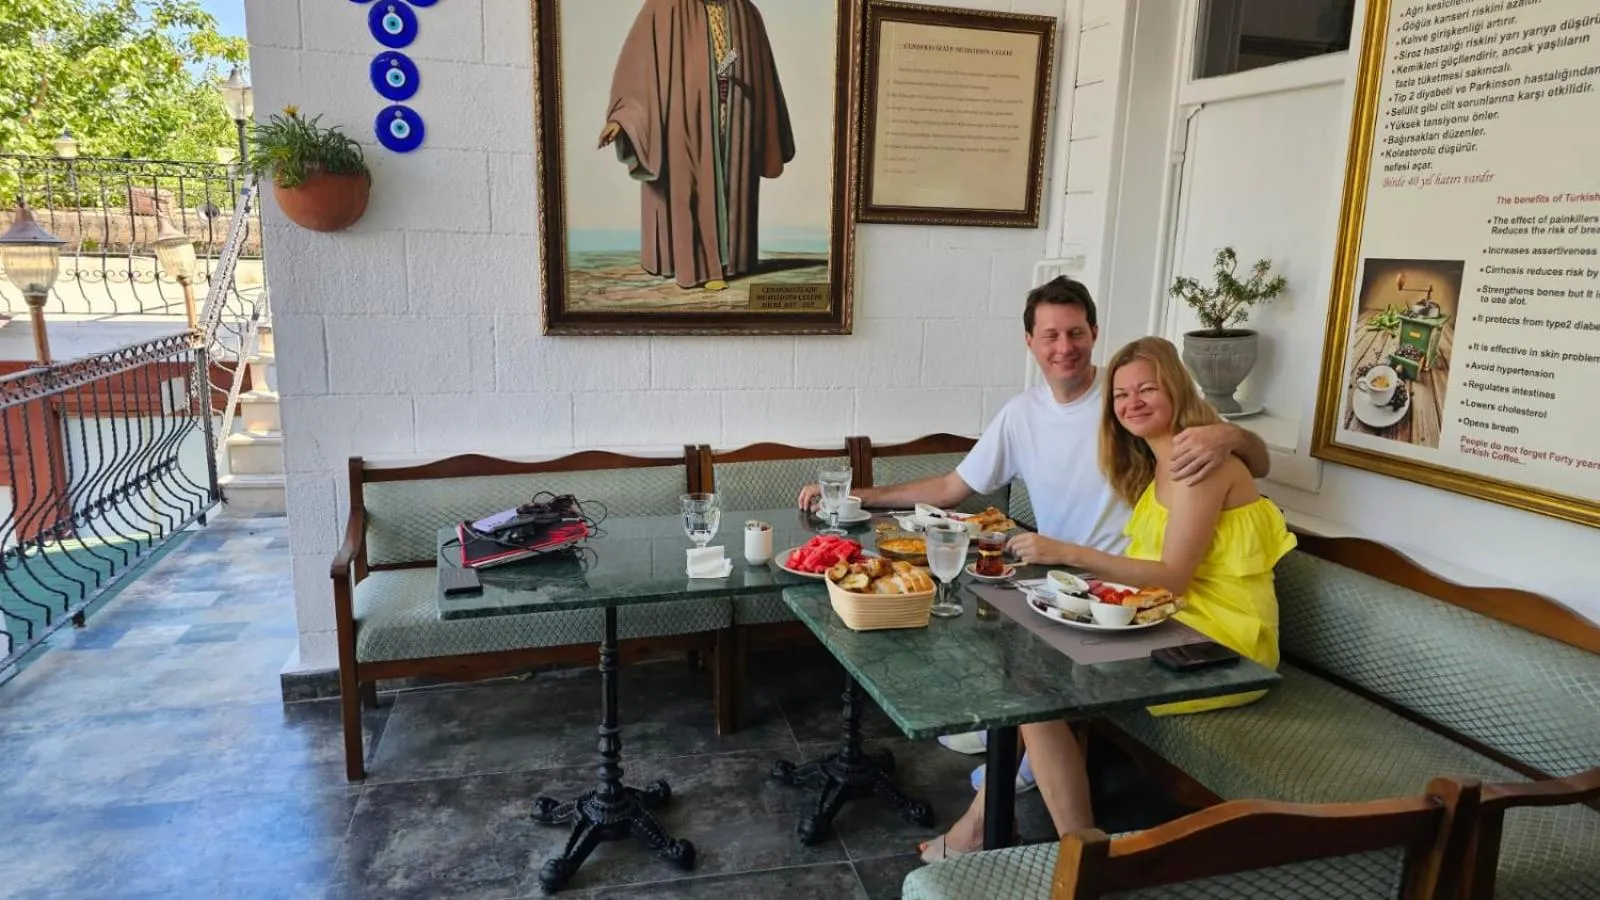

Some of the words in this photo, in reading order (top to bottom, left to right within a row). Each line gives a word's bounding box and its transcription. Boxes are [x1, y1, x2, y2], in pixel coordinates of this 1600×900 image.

[1434, 11, 1469, 25] kanseri
[1472, 2, 1504, 17] riskini
[1399, 48, 1422, 61] Siroz
[1466, 33, 1497, 48] riskini
[1560, 13, 1600, 31] düşürü
[1401, 33, 1428, 46] Kahve
[1396, 61, 1439, 75] Kemikleri
[1502, 43, 1534, 58] ancak
[1395, 77, 1415, 88] fazla
[1409, 92, 1414, 101] 2
[1417, 84, 1453, 99] diyabeti
[1456, 85, 1466, 94] ve
[1469, 74, 1520, 91] Parkinson
[1421, 102, 1438, 115] gibi
[1423, 114, 1469, 128] tansiyonu
[1442, 127, 1486, 139] düzenler.
[1384, 161, 1410, 171] nefesi
[1497, 196, 1511, 204] The
[1514, 194, 1550, 204] benefits
[1552, 194, 1562, 203] of
[1493, 216, 1509, 224] The
[1511, 216, 1536, 224] effect
[1538, 216, 1548, 224] of
[1550, 214, 1599, 224] painkillers
[1492, 226, 1528, 234] Reduces
[1531, 226, 1546, 234] the
[1548, 226, 1565, 234] risk
[1568, 226, 1578, 234] of
[1581, 226, 1600, 234] brea
[1488, 246, 1529, 254] Increases
[1532, 247, 1597, 255] assertiveness
[1485, 266, 1524, 274] Cirrhosis
[1526, 267, 1563, 276] reduces
[1566, 268, 1584, 276] risk
[1586, 268, 1599, 278] by
[1482, 285, 1534, 296] Strengthens
[1537, 288, 1565, 297] bones
[1568, 290, 1584, 298] but
[1480, 295, 1488, 303] to
[1491, 296, 1506, 304] use
[1485, 315, 1520, 324] protects
[1522, 317, 1544, 326] from
[1574, 321, 1600, 330] diabe
[1490, 344, 1527, 355] effective
[1540, 350, 1560, 358] skin
[1471, 362, 1495, 371] Avoid
[1496, 366, 1555, 379] hypertension
[1468, 380, 1510, 393] Regulates
[1512, 388, 1556, 400] intestines
[1466, 399, 1495, 410] Lowers
[1498, 404, 1547, 418] cholesterol
[1463, 418, 1489, 429] Opens
[1492, 422, 1519, 434] breath
[1460, 435, 1489, 448] People
[1490, 441, 1501, 450] do
[1504, 444, 1518, 453] not
[1520, 447, 1547, 460] forget
[1549, 452, 1573, 465] Forty
[1460, 444, 1489, 458] Turkish
